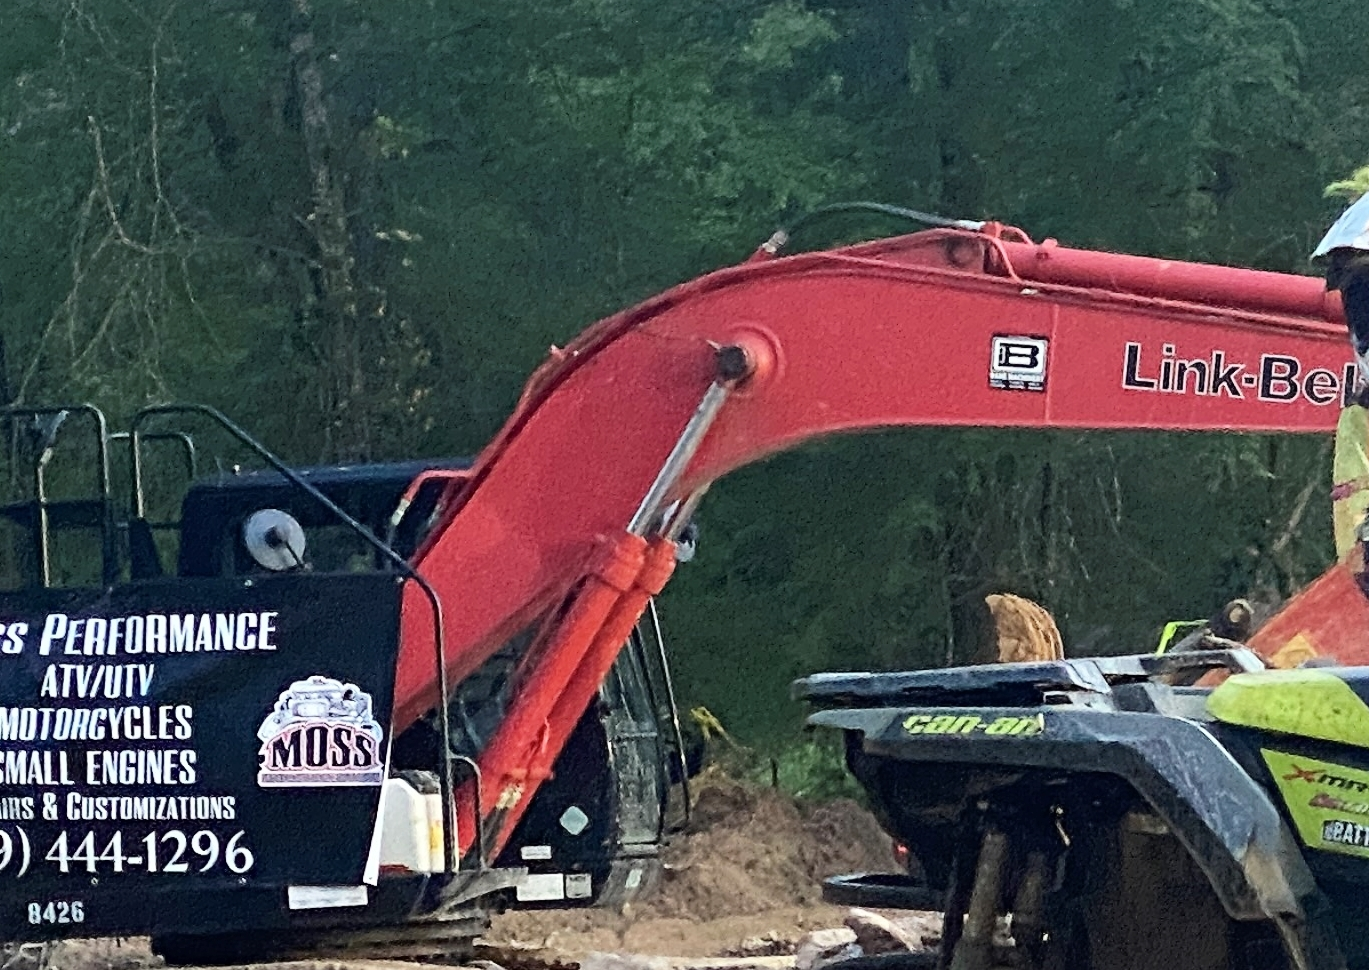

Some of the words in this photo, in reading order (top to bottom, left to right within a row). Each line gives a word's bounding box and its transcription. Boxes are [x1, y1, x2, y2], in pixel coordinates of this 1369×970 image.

[1122, 341, 1358, 406] Link-Bel
[0, 622, 29, 654] S
[39, 611, 279, 656] PERFORMANCE
[41, 663, 155, 699] ATV/UTV
[0, 704, 193, 741] MOTORCYCLES
[272, 725, 373, 768] MOSS
[0, 749, 76, 786] MALL
[86, 749, 197, 785] ENGINES
[0, 796, 35, 820] IRS
[42, 791, 59, 820] &
[66, 791, 236, 820] CUSTOMIZATIONS
[44, 829, 254, 874] 444-1296
[27, 901, 85, 925] 8426
